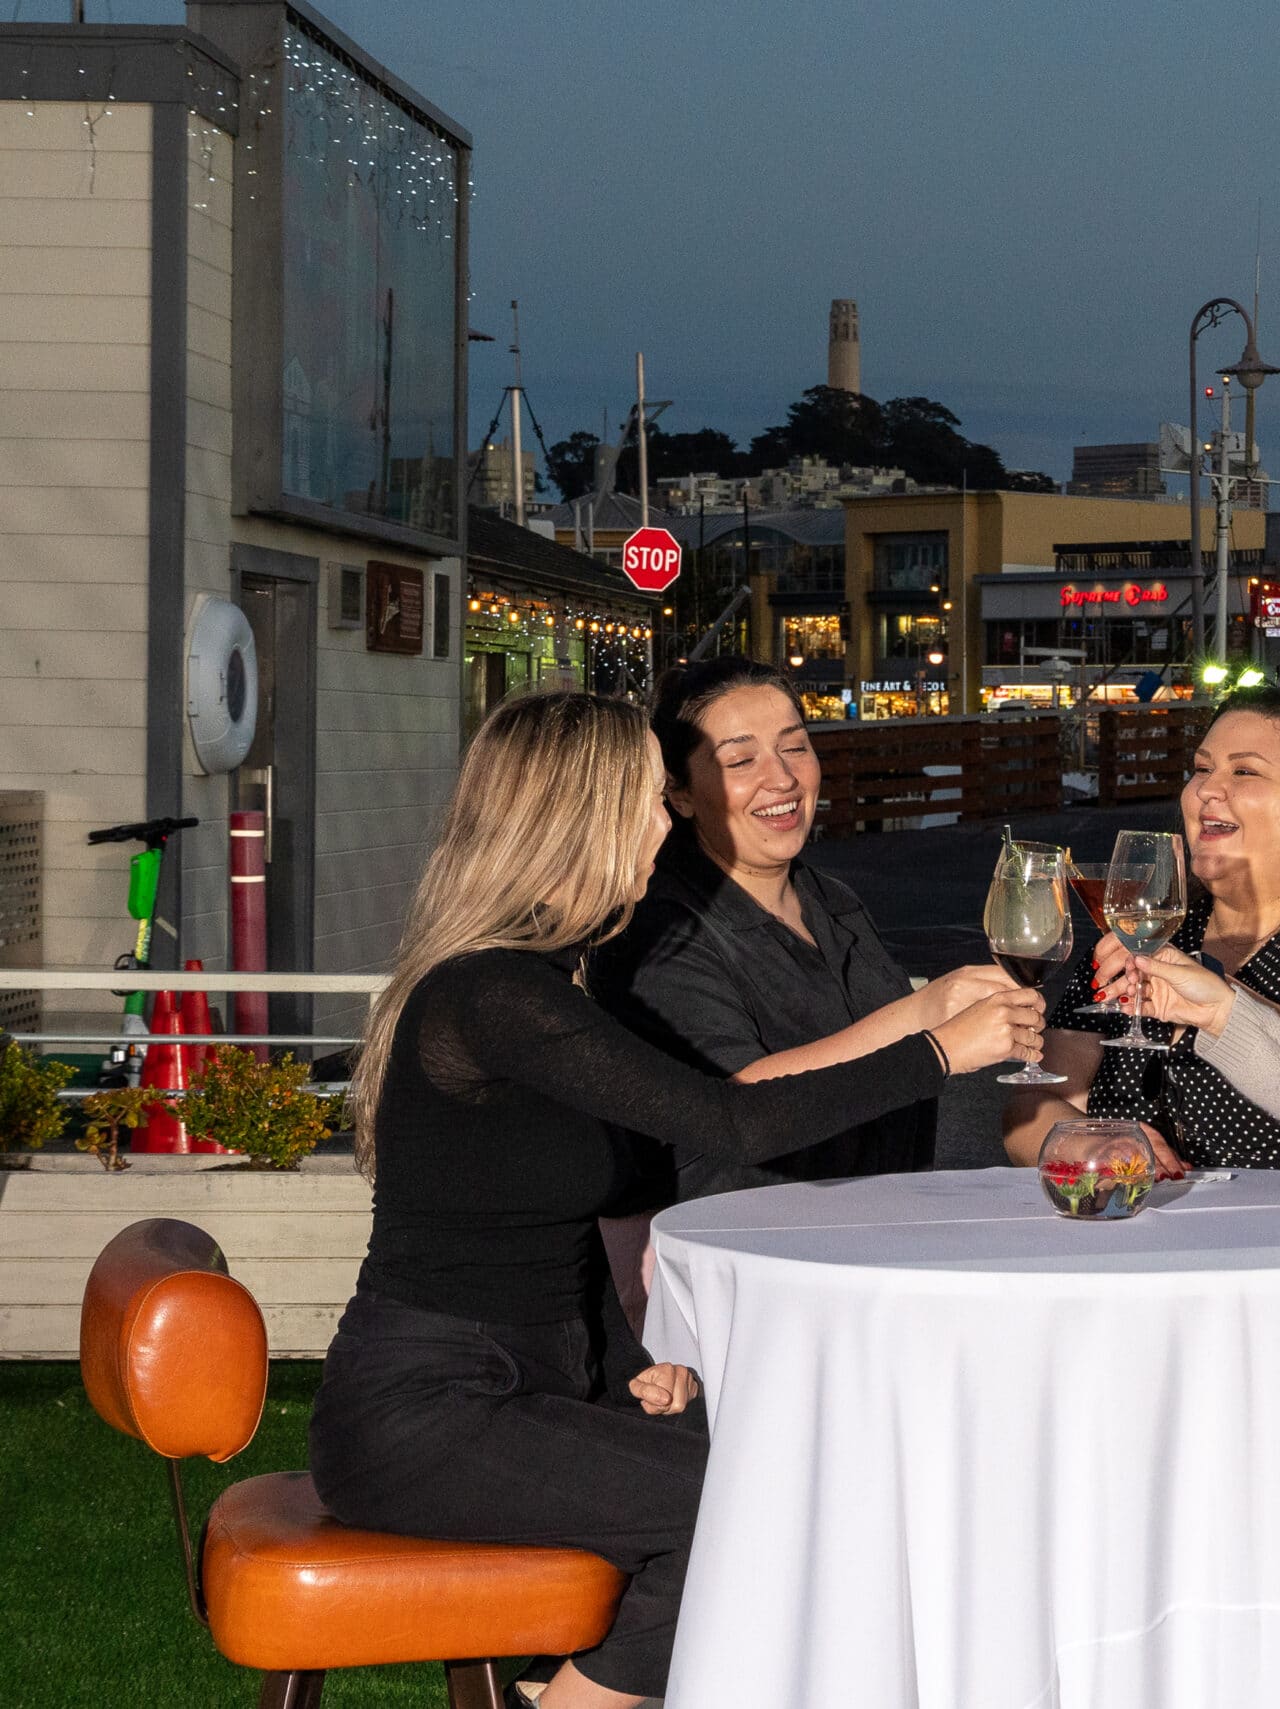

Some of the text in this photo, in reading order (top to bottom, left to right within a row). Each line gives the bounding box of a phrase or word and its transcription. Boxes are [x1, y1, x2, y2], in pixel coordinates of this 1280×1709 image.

[626, 545, 679, 573] STOP
[860, 680, 881, 692] FINE
[884, 680, 902, 692] ART
[902, 680, 912, 692] &
